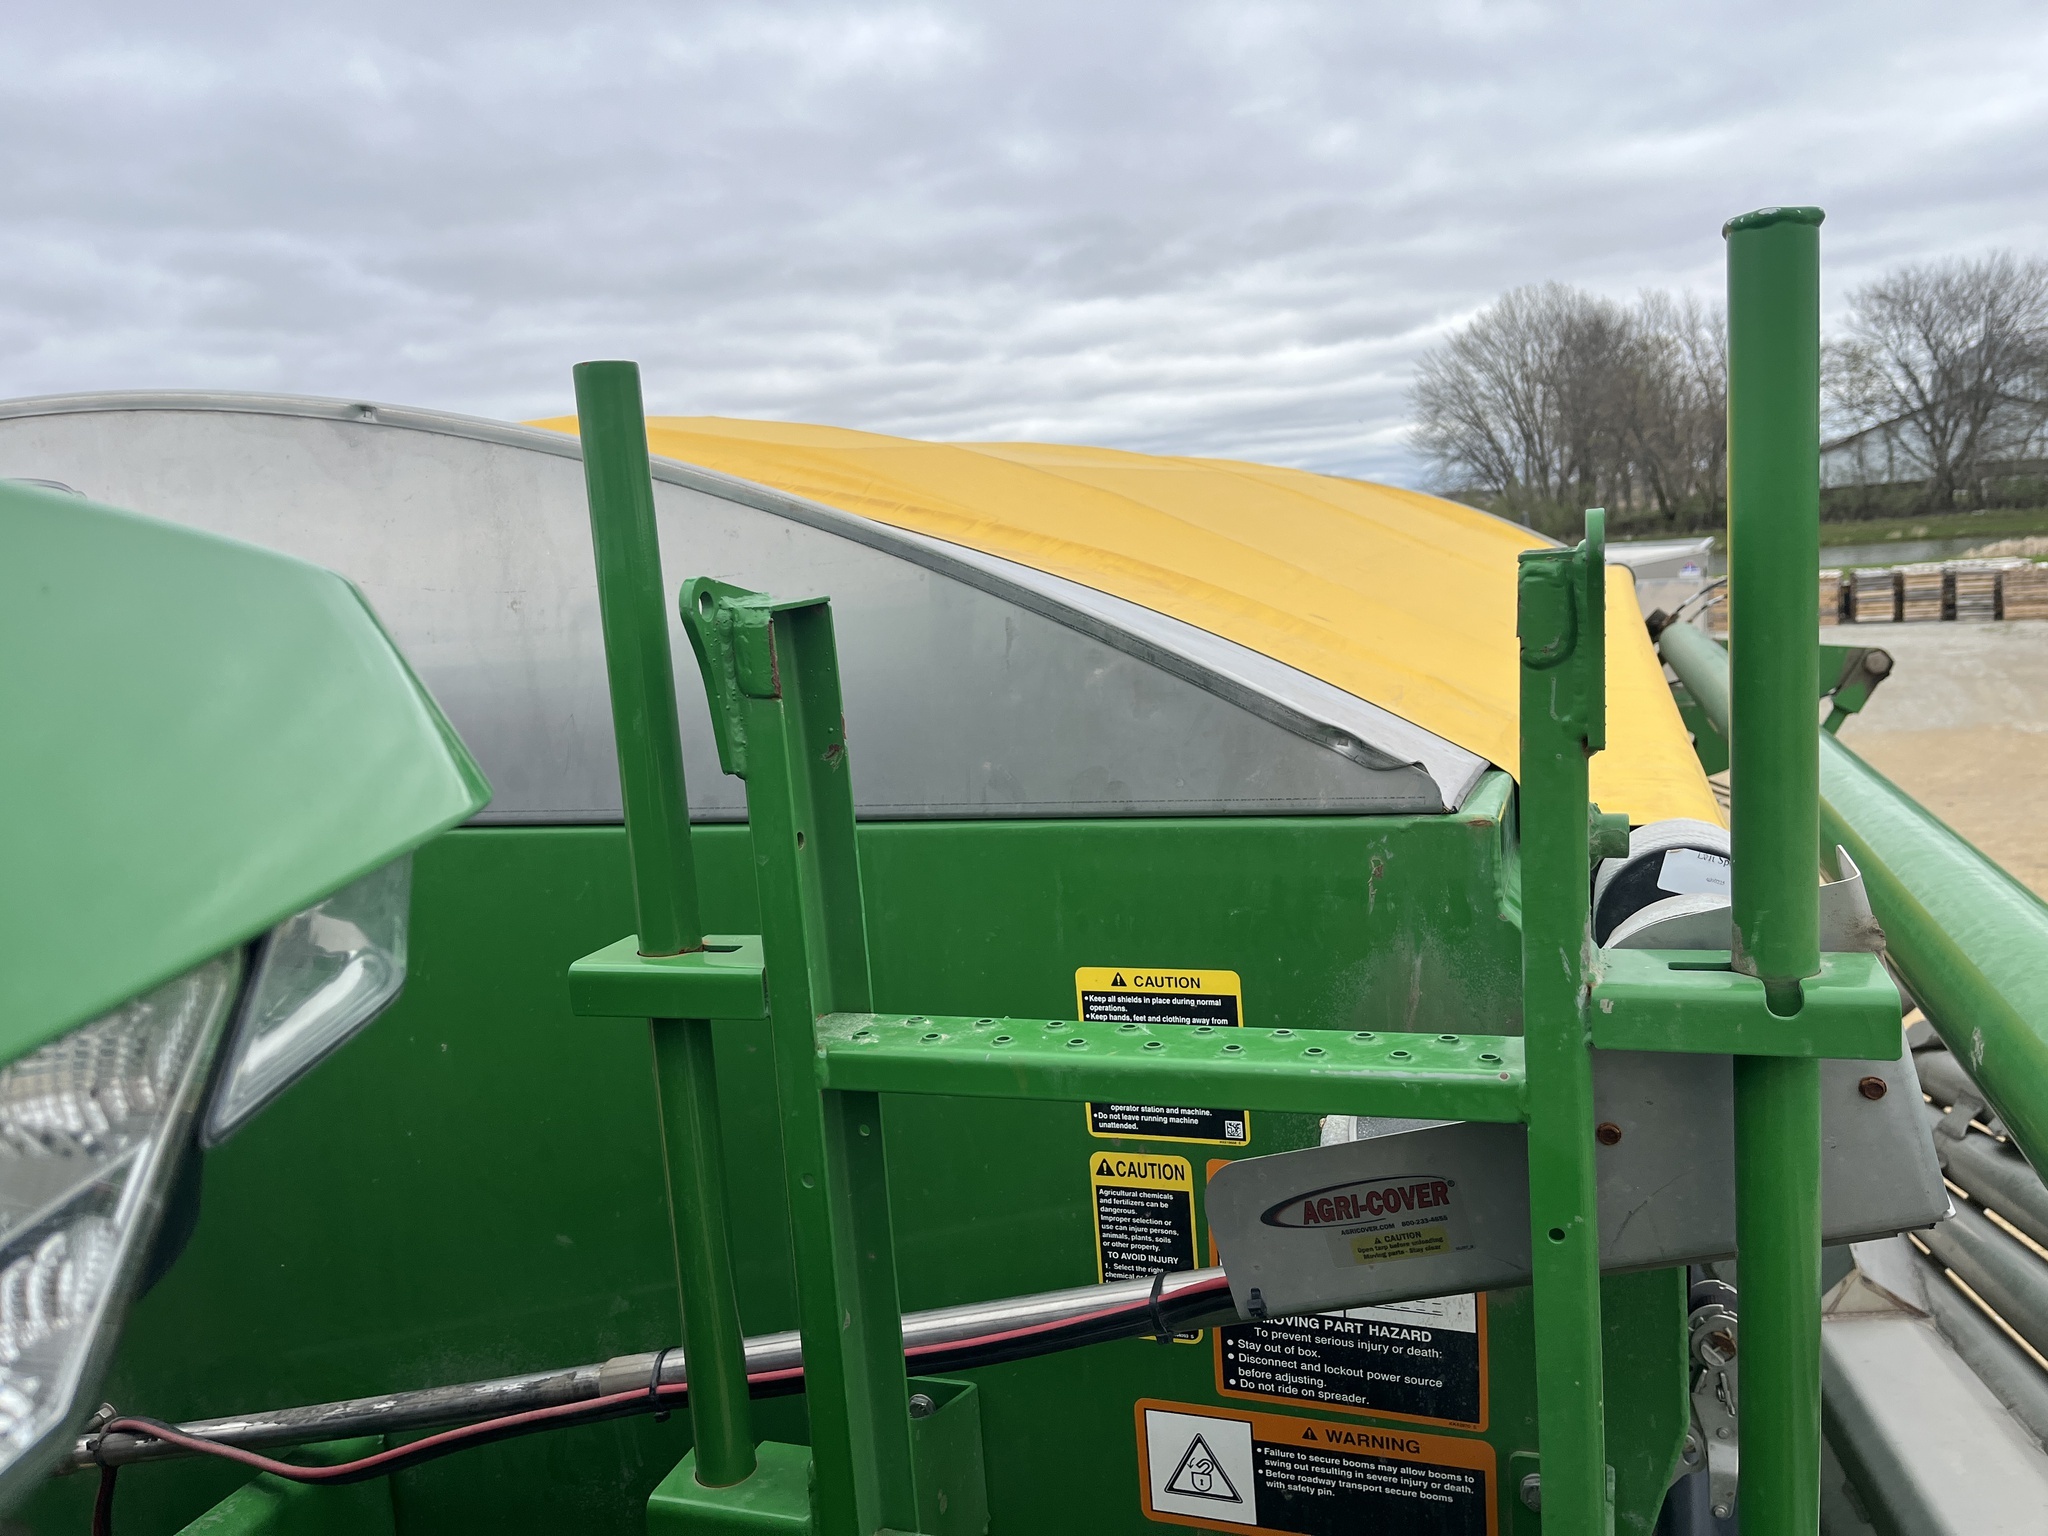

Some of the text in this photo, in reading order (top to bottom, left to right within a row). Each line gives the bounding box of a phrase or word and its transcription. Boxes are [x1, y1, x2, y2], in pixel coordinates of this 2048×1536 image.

[1134, 976, 1200, 988] CAUTION
[1089, 994, 1106, 1003] Keep
[1152, 997, 1170, 1005] place
[1172, 997, 1195, 1006] during
[1089, 1004, 1128, 1012] operations.
[1090, 1013, 1108, 1022] Keep
[1109, 1014, 1132, 1022] hands,
[1162, 1016, 1190, 1025] clothing
[1111, 1104, 1139, 1113] operator
[1141, 1105, 1164, 1113] station
[1180, 1108, 1212, 1116] machine.
[1122, 1113, 1139, 1121] leave
[1141, 1114, 1167, 1124] running
[1169, 1116, 1198, 1125] machine
[1099, 1121, 1138, 1130] unattended.
[1116, 1161, 1185, 1181] CAUTION
[1099, 1188, 1173, 1200] Agricultural chemicals
[1113, 1198, 1144, 1207] fertilizers
[1303, 1180, 1450, 1225] AGRI-COVER
[1100, 1206, 1137, 1215] dangerous.
[1101, 1215, 1131, 1223] Improper
[1132, 1216, 1162, 1226] selection
[1129, 1225, 1148, 1234] injure
[1150, 1227, 1179, 1236] persons,
[1341, 1223, 1395, 1236] AGRICOVER.COM
[1102, 1232, 1130, 1240] animals,
[1131, 1234, 1154, 1242] plants,
[1384, 1232, 1422, 1243] CAUTION
[1130, 1243, 1160, 1252] property.
[1357, 1246, 1374, 1254] Open
[1375, 1244, 1388, 1252] tarp
[1411, 1237, 1444, 1246] unloading
[1107, 1251, 1179, 1264] TO AVOID INJURY
[1363, 1252, 1387, 1260] Moving
[1388, 1250, 1404, 1258] parts
[1114, 1263, 1134, 1271] Select
[1262, 1316, 1432, 1342] OVING PART HAZARD
[1238, 1339, 1321, 1358] Stay out of box.
[1254, 1327, 1442, 1358] To prevent serious injury or death:
[1238, 1353, 1442, 1388] Disconnect and lockout power source
[1238, 1367, 1327, 1388] before adjusting.
[1240, 1379, 1370, 1404] Do not ride on spreader.
[1325, 1429, 1420, 1454] WARNING
[1264, 1447, 1474, 1483] Failure to secure booms may allow booms to
[1265, 1459, 1291, 1470] swing
[1294, 1463, 1309, 1471] out
[1311, 1465, 1352, 1478] resulting
[1355, 1470, 1364, 1478] in
[1366, 1473, 1398, 1484] severe
[1400, 1477, 1428, 1489] injury
[1444, 1483, 1474, 1494] death.
[1265, 1469, 1453, 1502] Before roadway transport secure booms
[1266, 1481, 1335, 1496] with safety pin.
